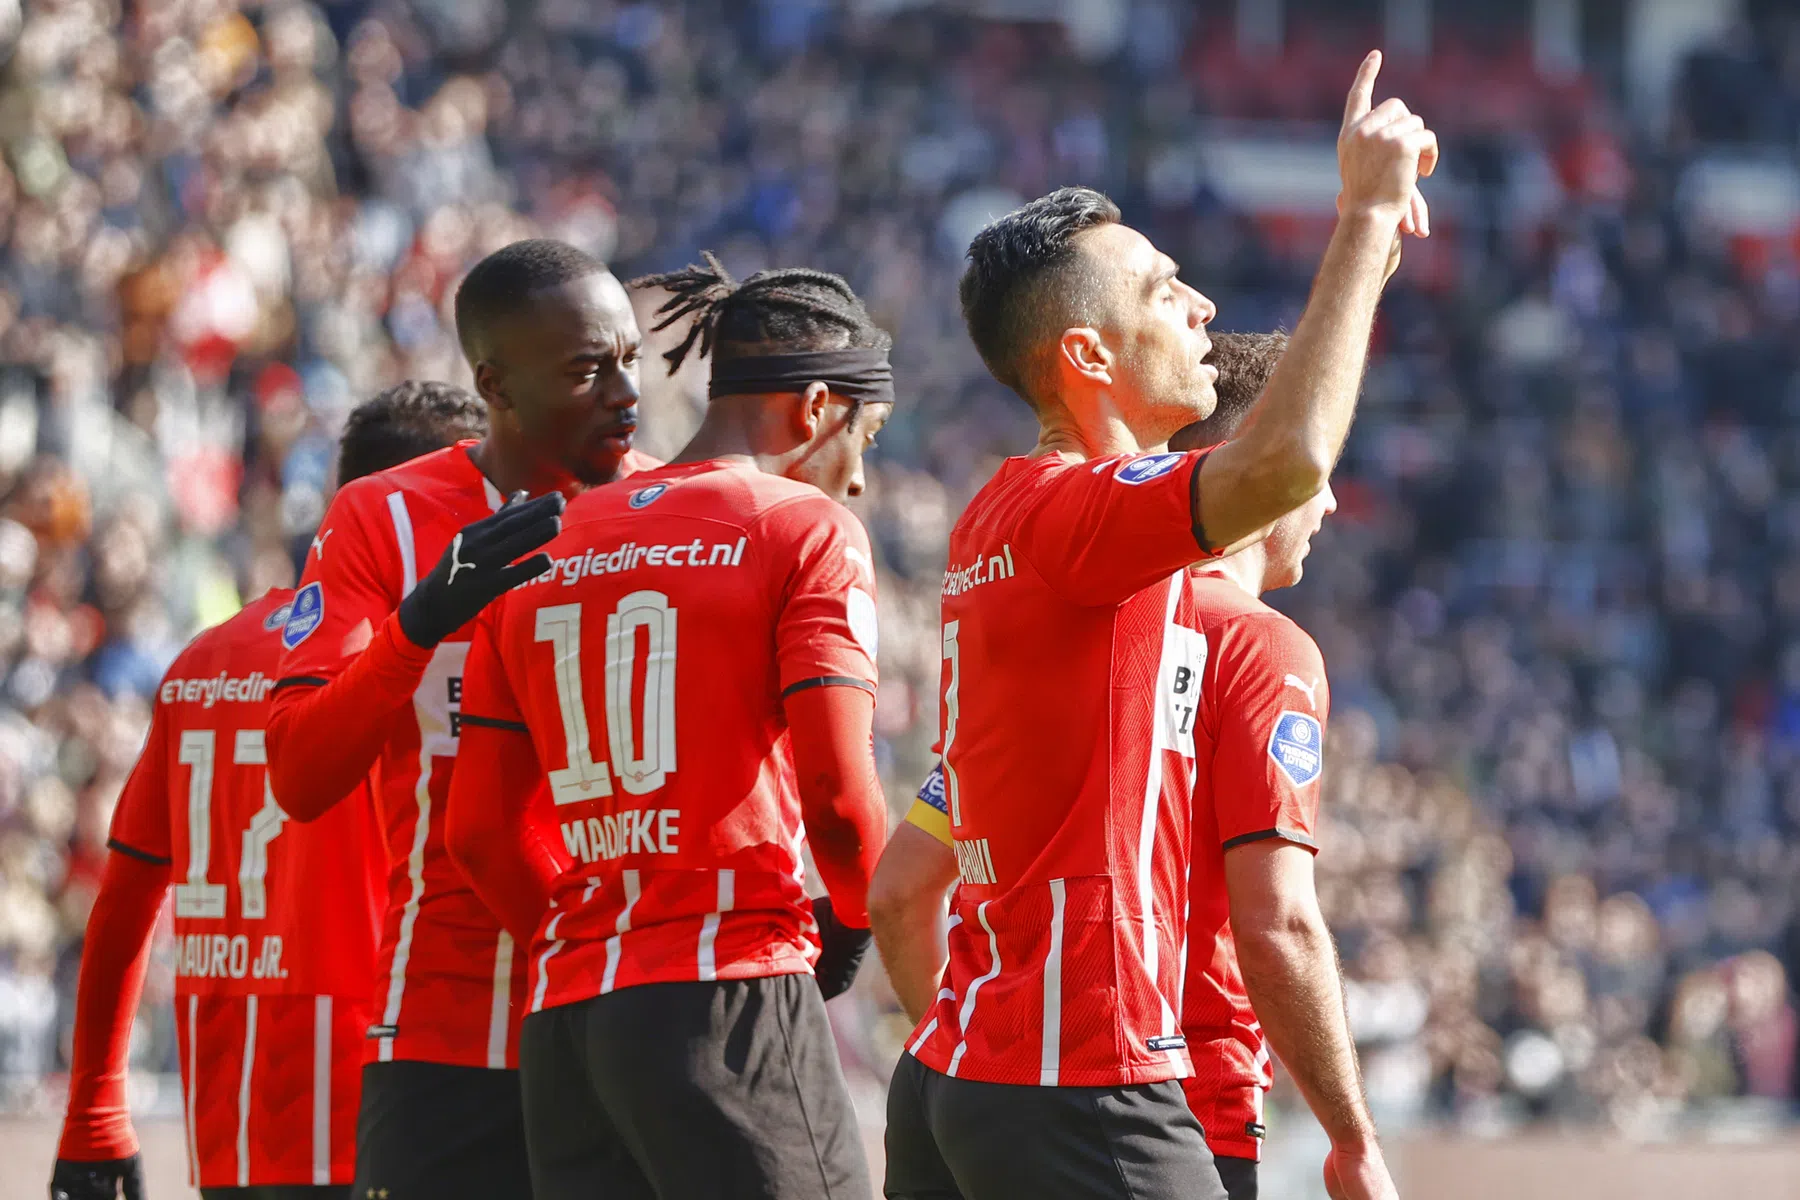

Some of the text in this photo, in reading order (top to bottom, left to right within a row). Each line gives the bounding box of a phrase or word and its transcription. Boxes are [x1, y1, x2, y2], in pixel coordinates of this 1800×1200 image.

[161, 670, 278, 710] energiedir
[534, 590, 678, 805] 10
[175, 729, 290, 919] 17
[252, 935, 289, 979] JR.
